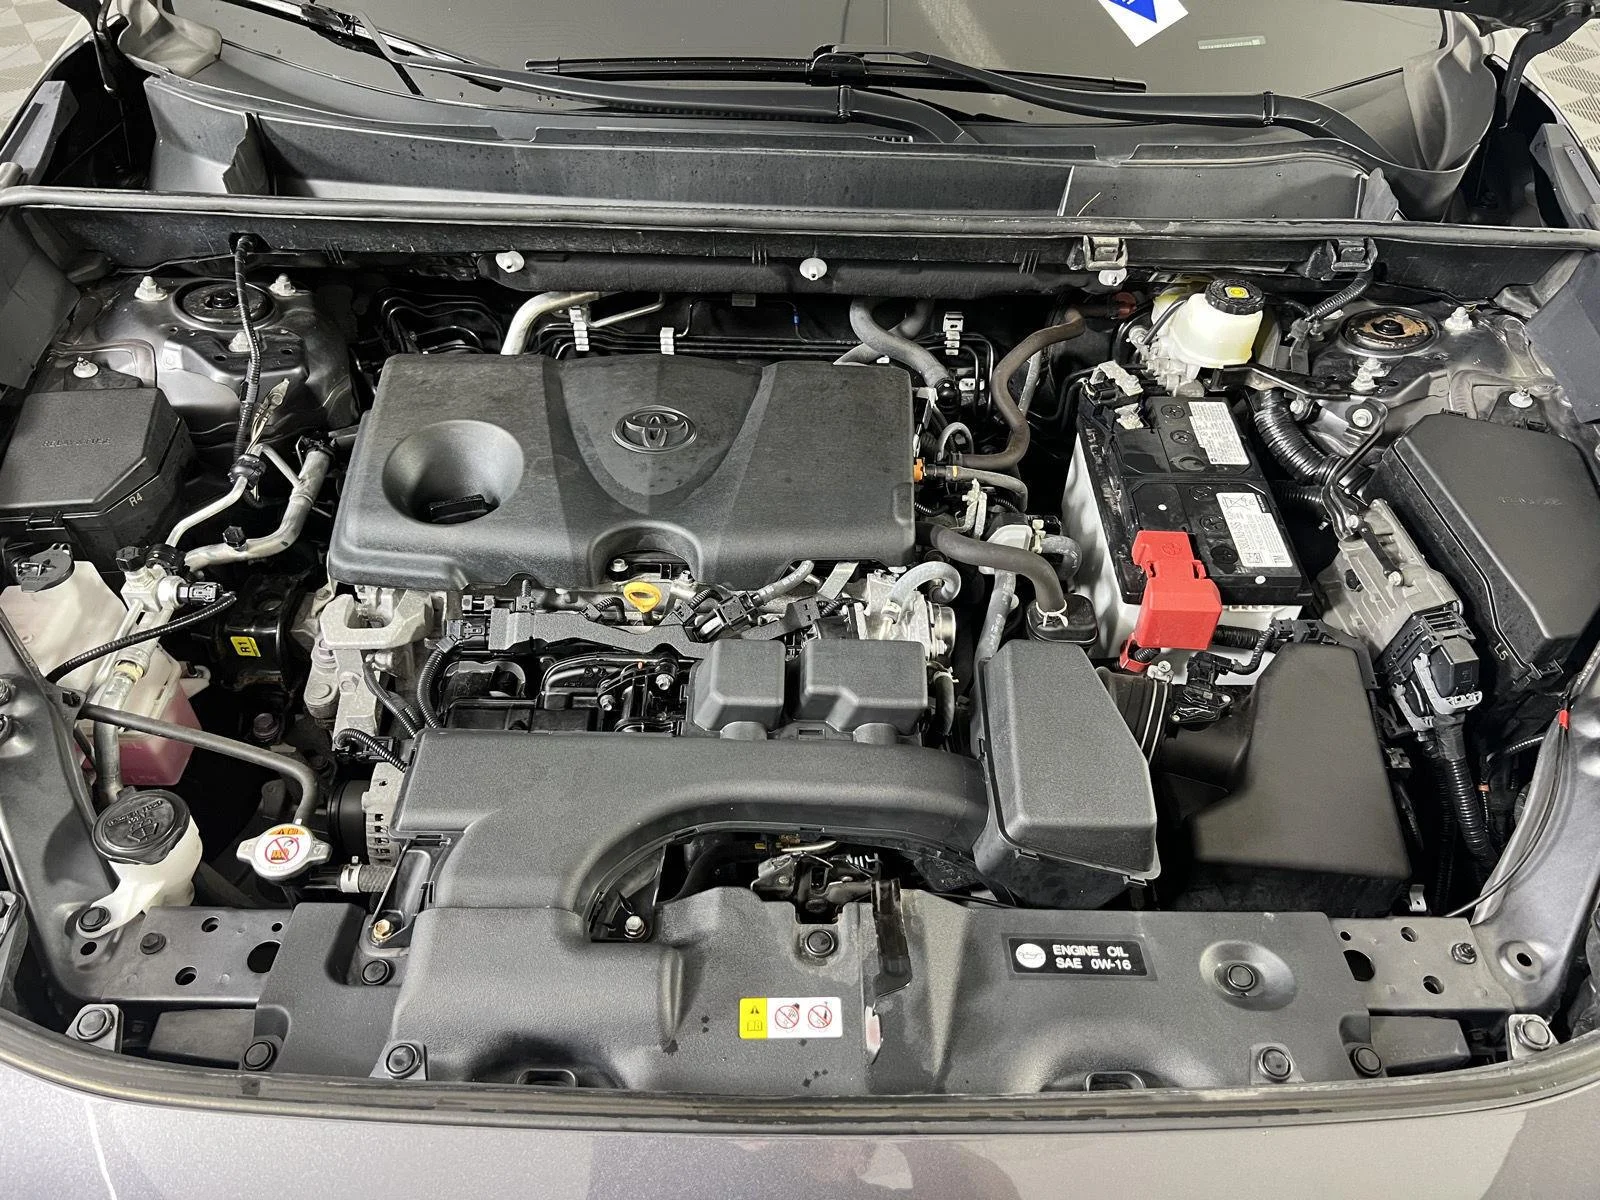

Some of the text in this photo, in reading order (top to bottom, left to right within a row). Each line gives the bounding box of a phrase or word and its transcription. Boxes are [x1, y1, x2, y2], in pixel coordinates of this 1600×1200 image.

[128, 492, 143, 507] R4
[237, 641, 252, 653] R1
[1494, 642, 1509, 661] L5
[1052, 944, 1129, 957] ENGINE OIL
[1055, 957, 1132, 970] SAE 0W-16
